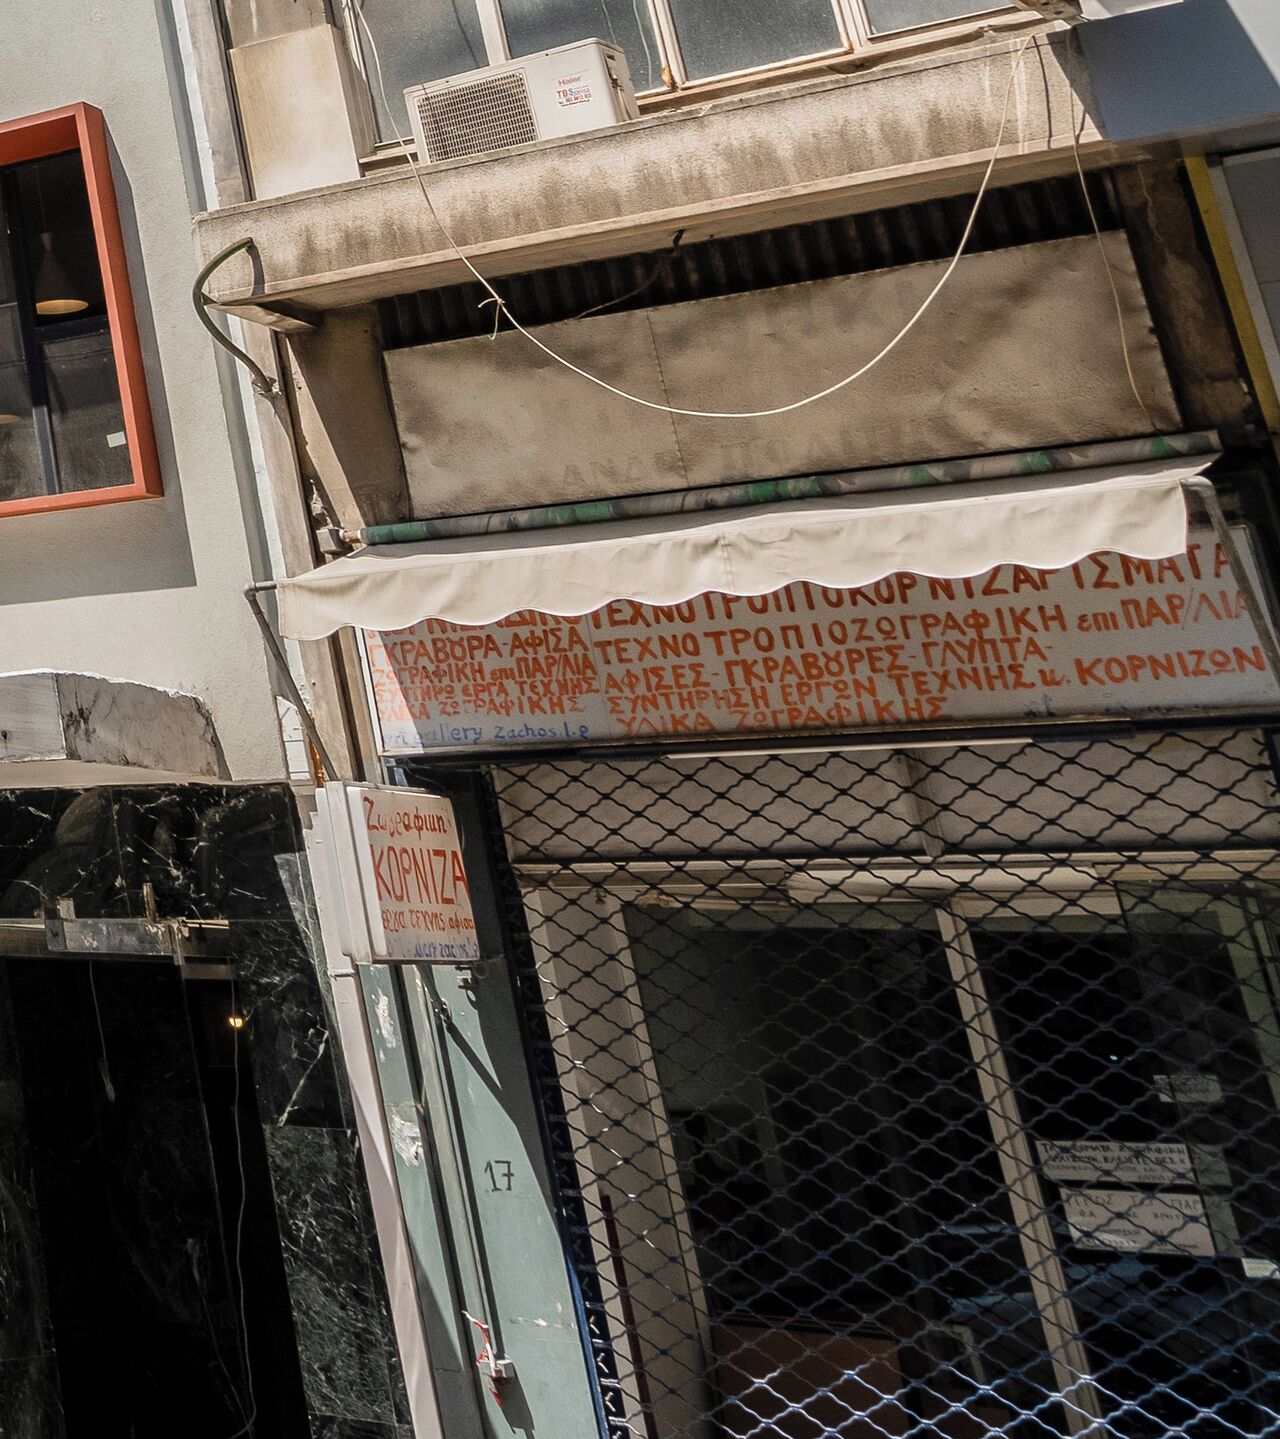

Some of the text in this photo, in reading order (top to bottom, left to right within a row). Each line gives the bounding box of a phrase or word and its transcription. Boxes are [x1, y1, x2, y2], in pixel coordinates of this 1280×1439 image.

[888, 663, 1036, 698] ΤΕΧΝΗΣ
[1075, 645, 1267, 686] ΚΟΡΝΙΖΩΝ
[484, 1159, 515, 1192] 17
